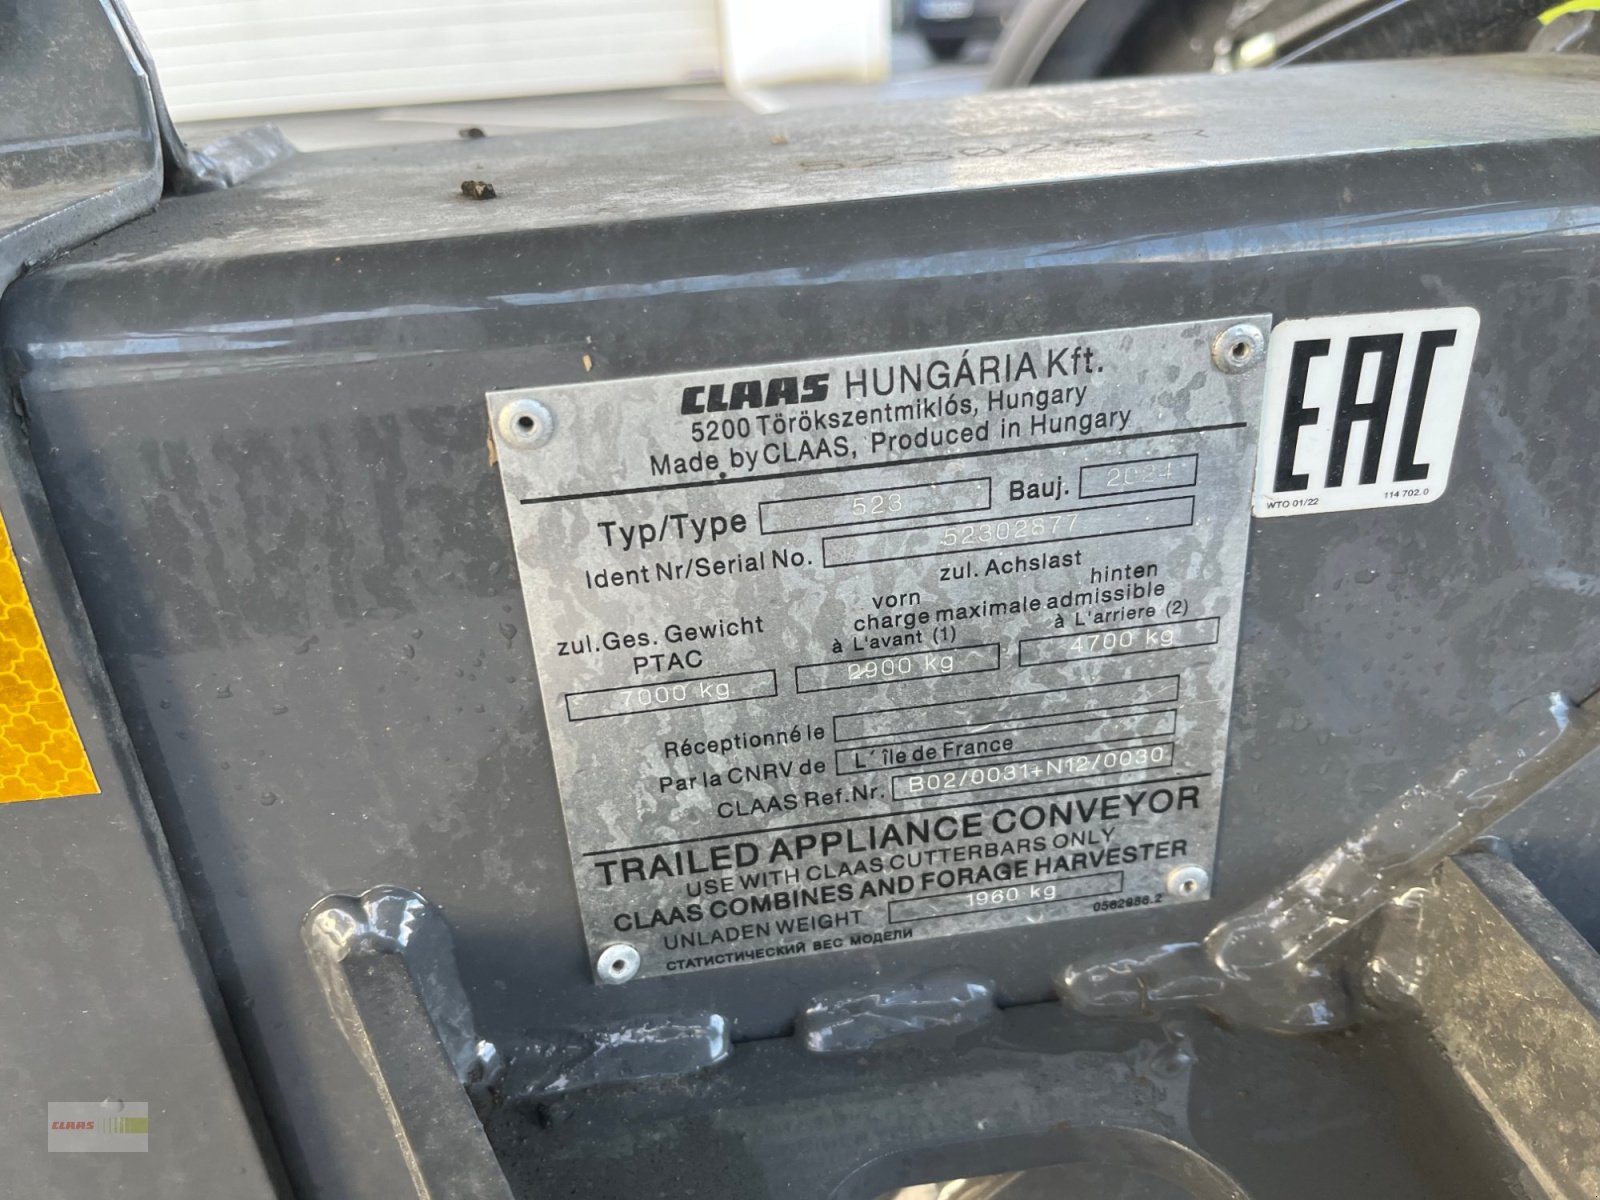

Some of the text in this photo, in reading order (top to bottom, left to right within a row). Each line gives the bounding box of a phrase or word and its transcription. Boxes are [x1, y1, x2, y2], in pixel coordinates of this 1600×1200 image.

[681, 346, 1103, 415] CLAAS HUNGÁRIA Kft.
[691, 385, 1087, 443] 5200 Törökszentmiklós, Hungary
[1273, 329, 1457, 494] EAC
[650, 409, 1131, 476] Made by CLAAS, Produced in Hungary
[1009, 475, 1069, 500] Bauj.
[1266, 498, 1319, 509] WTO 01/22
[1384, 491, 1400, 499] 114
[597, 493, 902, 551] Typ/Type 523
[586, 513, 1079, 589] Ident Nr/Serial No. 52302877
[940, 549, 1081, 581] zul. Achslast
[1090, 563, 1158, 584] hinten
[854, 582, 1165, 632] charge maximale admissible
[872, 592, 920, 609] vorn
[1054, 599, 1189, 628] à L'arriere (2)
[664, 616, 764, 643] Gewicht
[832, 626, 956, 653] à L'avant (1)
[1071, 629, 1173, 653] 4700 kg
[633, 650, 703, 675] PTAC
[848, 655, 953, 680] 2900 kg
[620, 682, 730, 707] 7000 kg
[664, 724, 825, 758] Réceptionné le
[660, 776, 697, 793] Par
[703, 771, 722, 788] la
[728, 761, 793, 784] CNRV
[800, 759, 826, 775] de
[912, 744, 937, 762] de
[943, 737, 1013, 758] France
[717, 795, 798, 818] CLAAS
[909, 746, 1163, 793] B02/0031+N12/0030
[595, 785, 1200, 886] TRAILED APPLIANCE CONVEYOR
[686, 827, 1116, 897] USE WITH CLAAS CUTTERBARS ONLY
[614, 839, 1187, 932] CLAAS COMBINES AND FORAGE HARVESTER
[664, 884, 1056, 950] UNLADEN WEIGHT 1960 kg
[666, 928, 913, 971] СТАТИСТИЧЕСКИЙ ВЕС МОДЕЛИ
